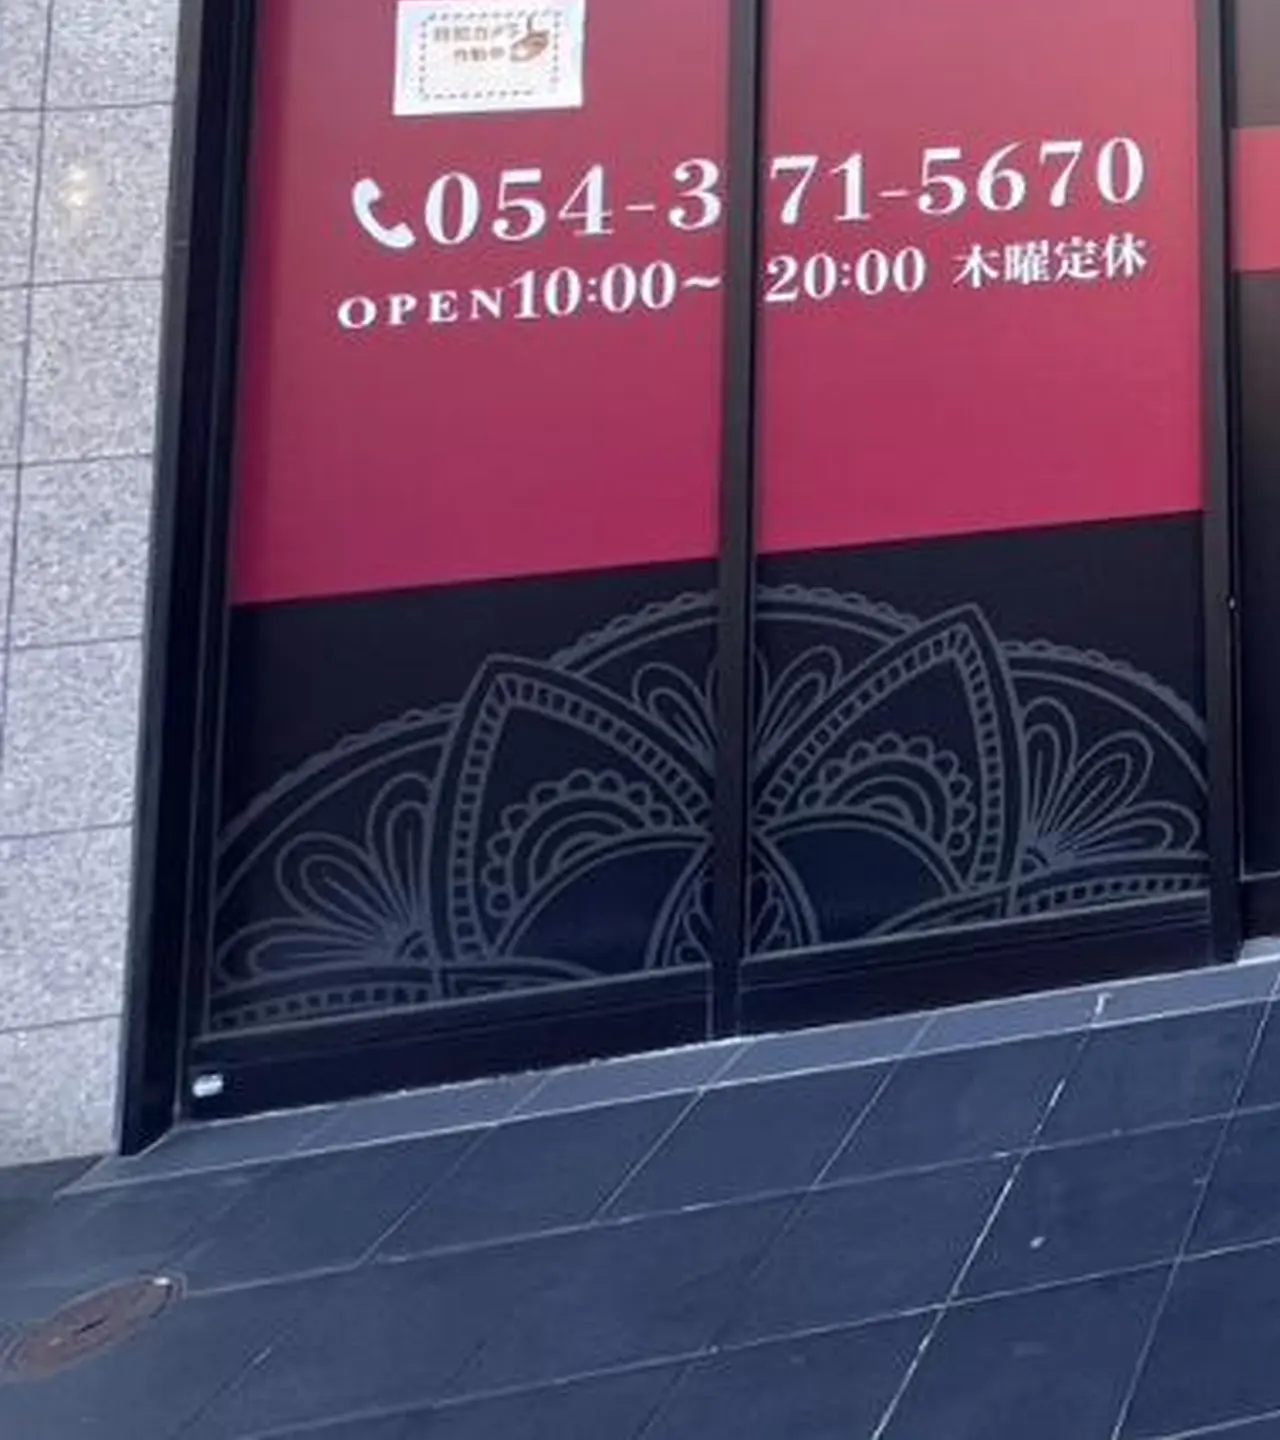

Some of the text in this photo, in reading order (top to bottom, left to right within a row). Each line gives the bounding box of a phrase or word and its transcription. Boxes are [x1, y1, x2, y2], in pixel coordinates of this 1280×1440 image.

[424, 137, 1145, 246] 054-371-5670
[954, 231, 1147, 289] 木曜定休
